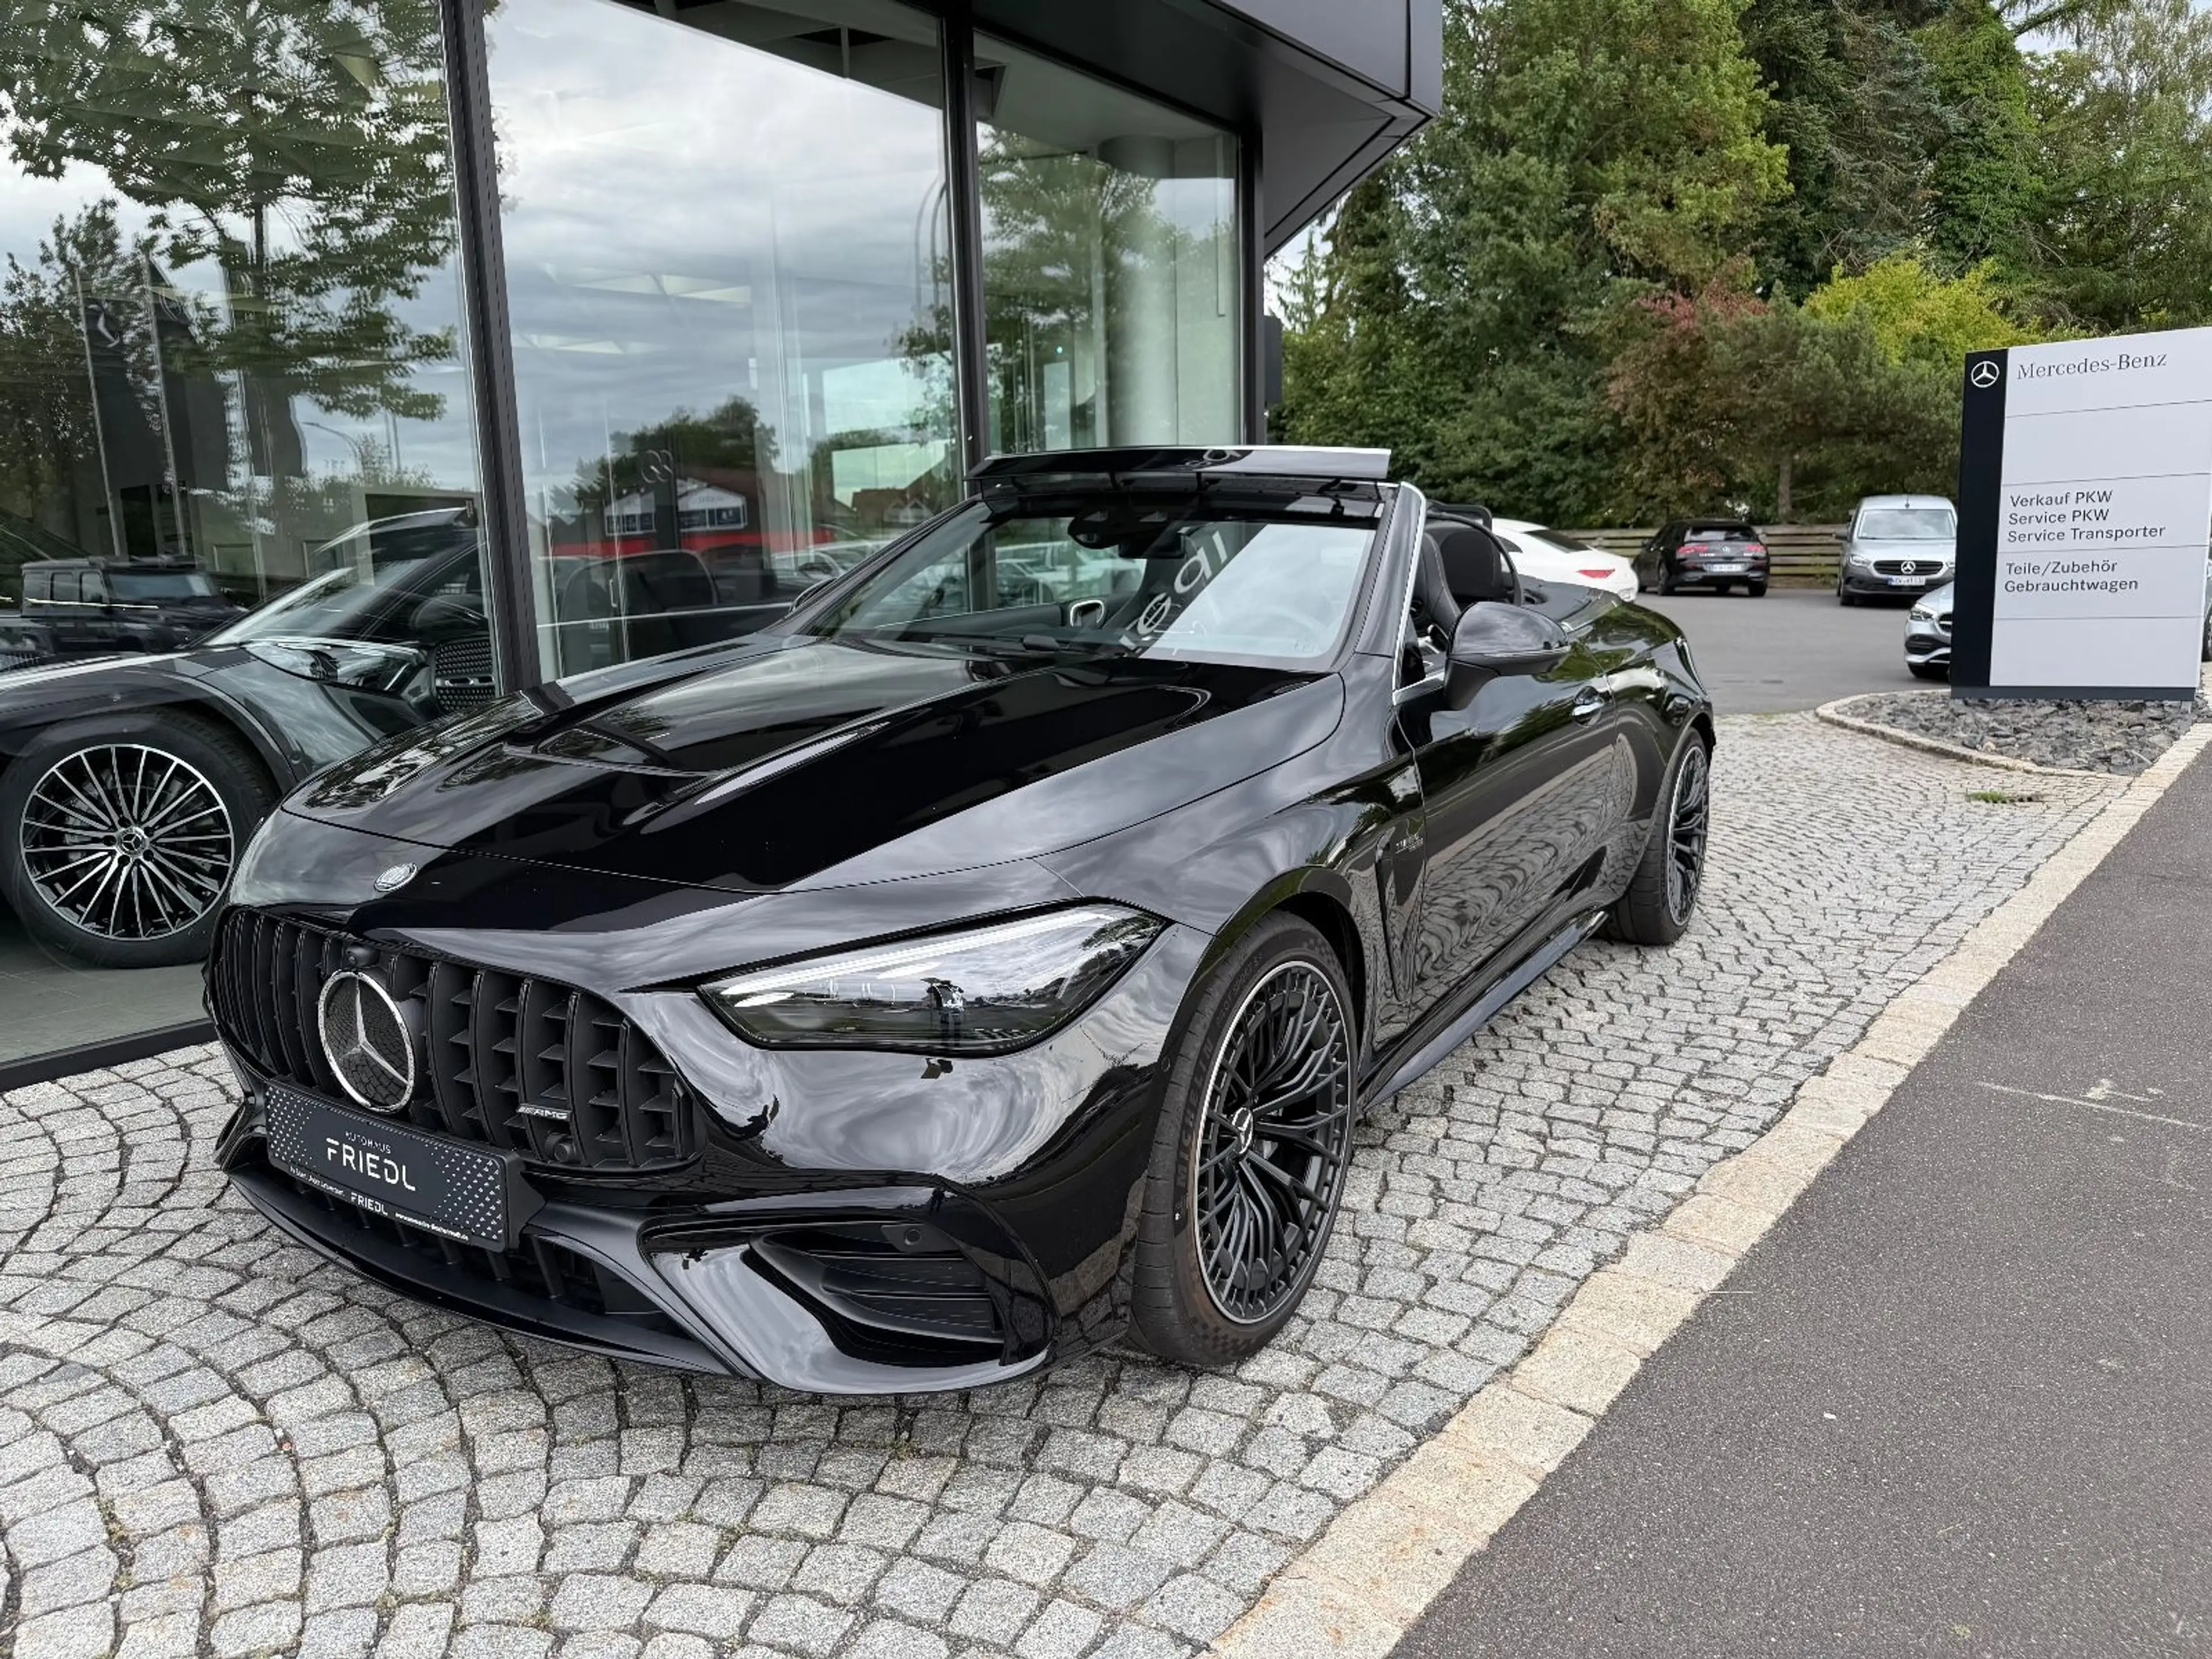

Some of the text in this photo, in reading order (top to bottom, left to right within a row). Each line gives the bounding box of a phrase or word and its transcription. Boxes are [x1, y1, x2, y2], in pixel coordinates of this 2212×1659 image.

[2016, 353, 2168, 380] Mercedes-Benz
[2009, 490, 2113, 507] Verkauf PKW
[2008, 509, 2109, 525] Service PKW
[2007, 526, 2166, 543] Service Transporter
[2005, 559, 2118, 576] Teile/Zubehör
[2004, 579, 2138, 593] Gebrauchtwagen
[1176, 1036, 1214, 1188] MICHELIN
[326, 1137, 416, 1191] FRIEDL
[351, 1191, 388, 1215] FRIEDL
